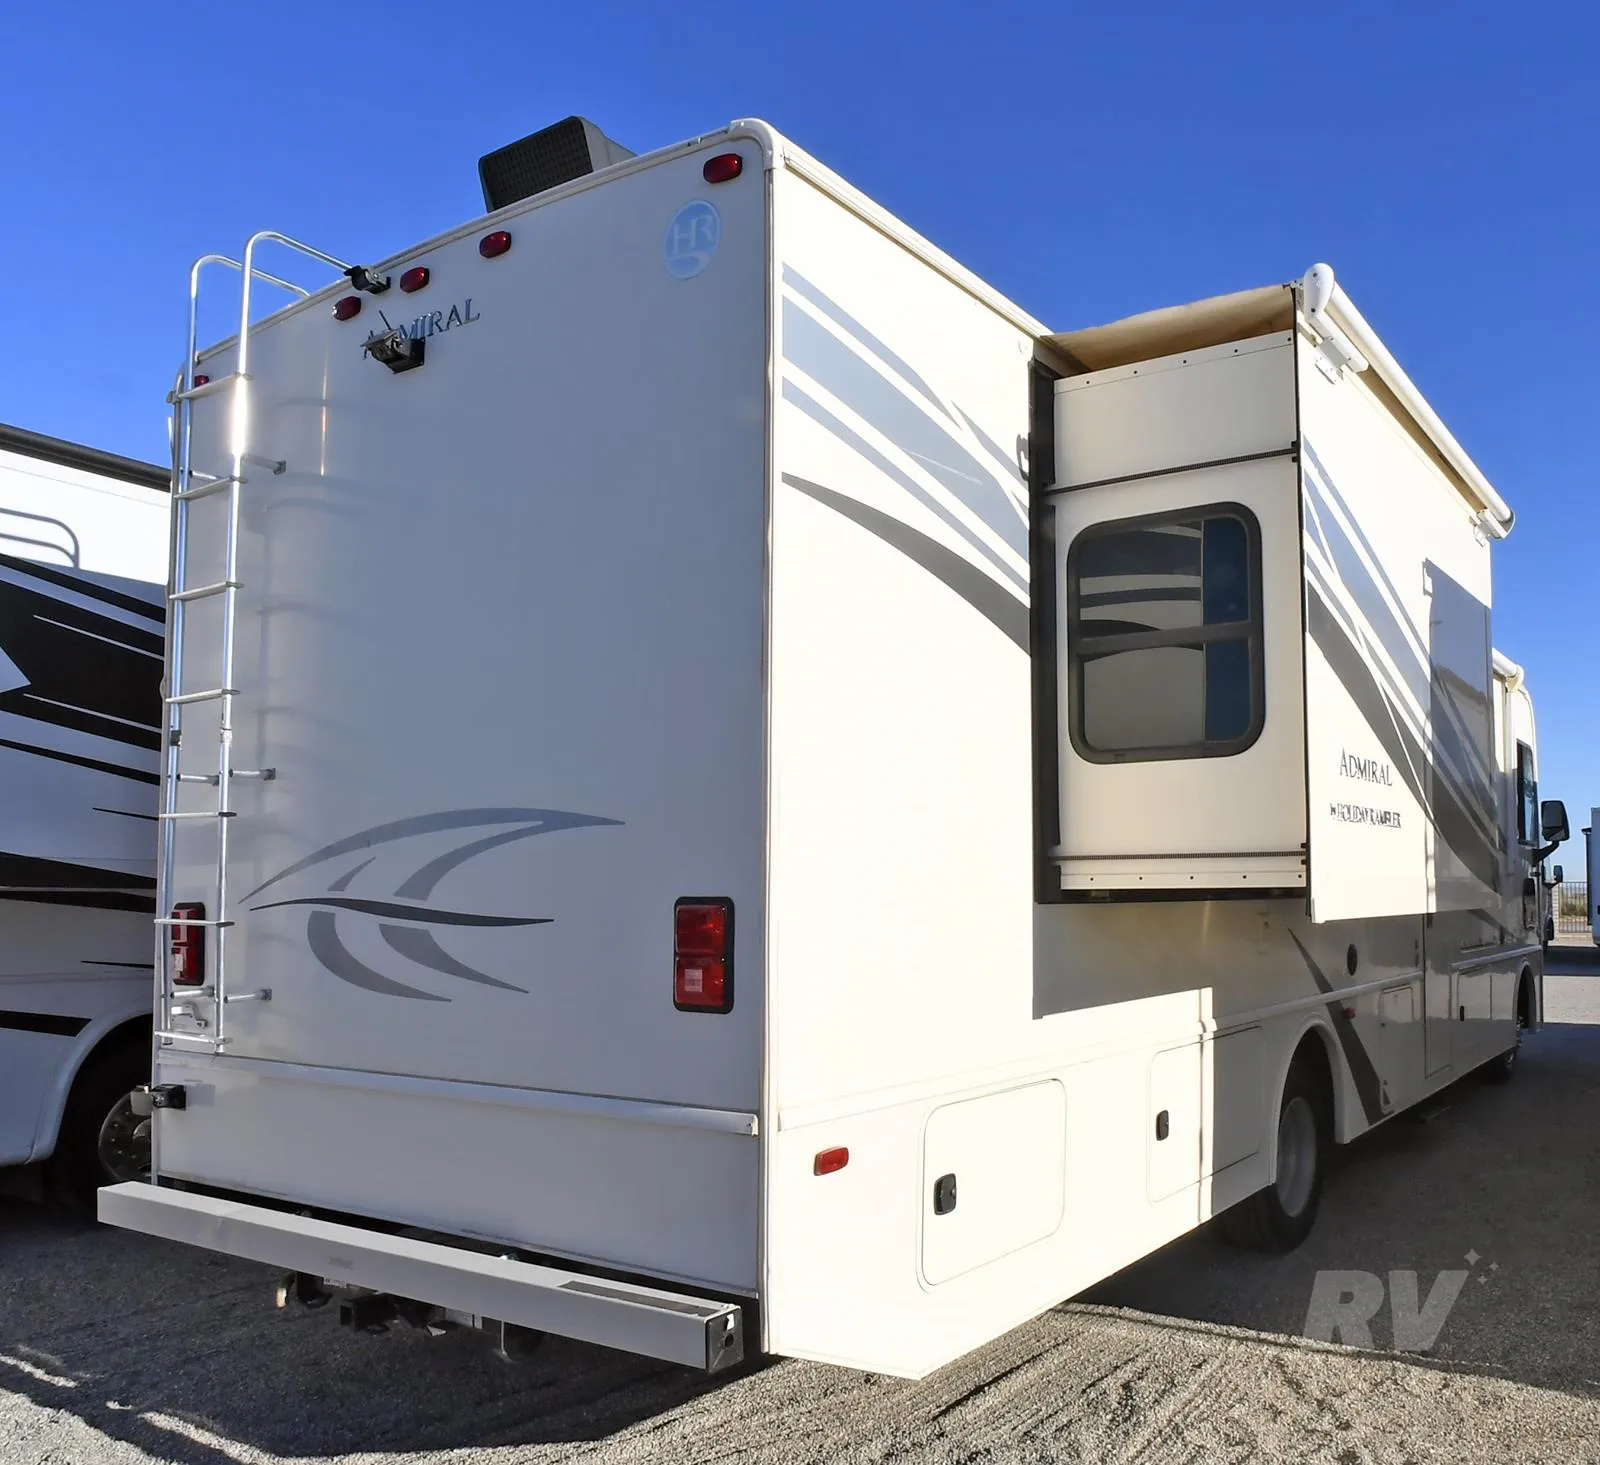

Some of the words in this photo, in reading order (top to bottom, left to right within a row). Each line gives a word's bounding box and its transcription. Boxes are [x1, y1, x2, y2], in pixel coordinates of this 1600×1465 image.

[673, 214, 715, 256] HR
[363, 299, 480, 360] MIRAL
[1340, 747, 1392, 786] ADMIRAL
